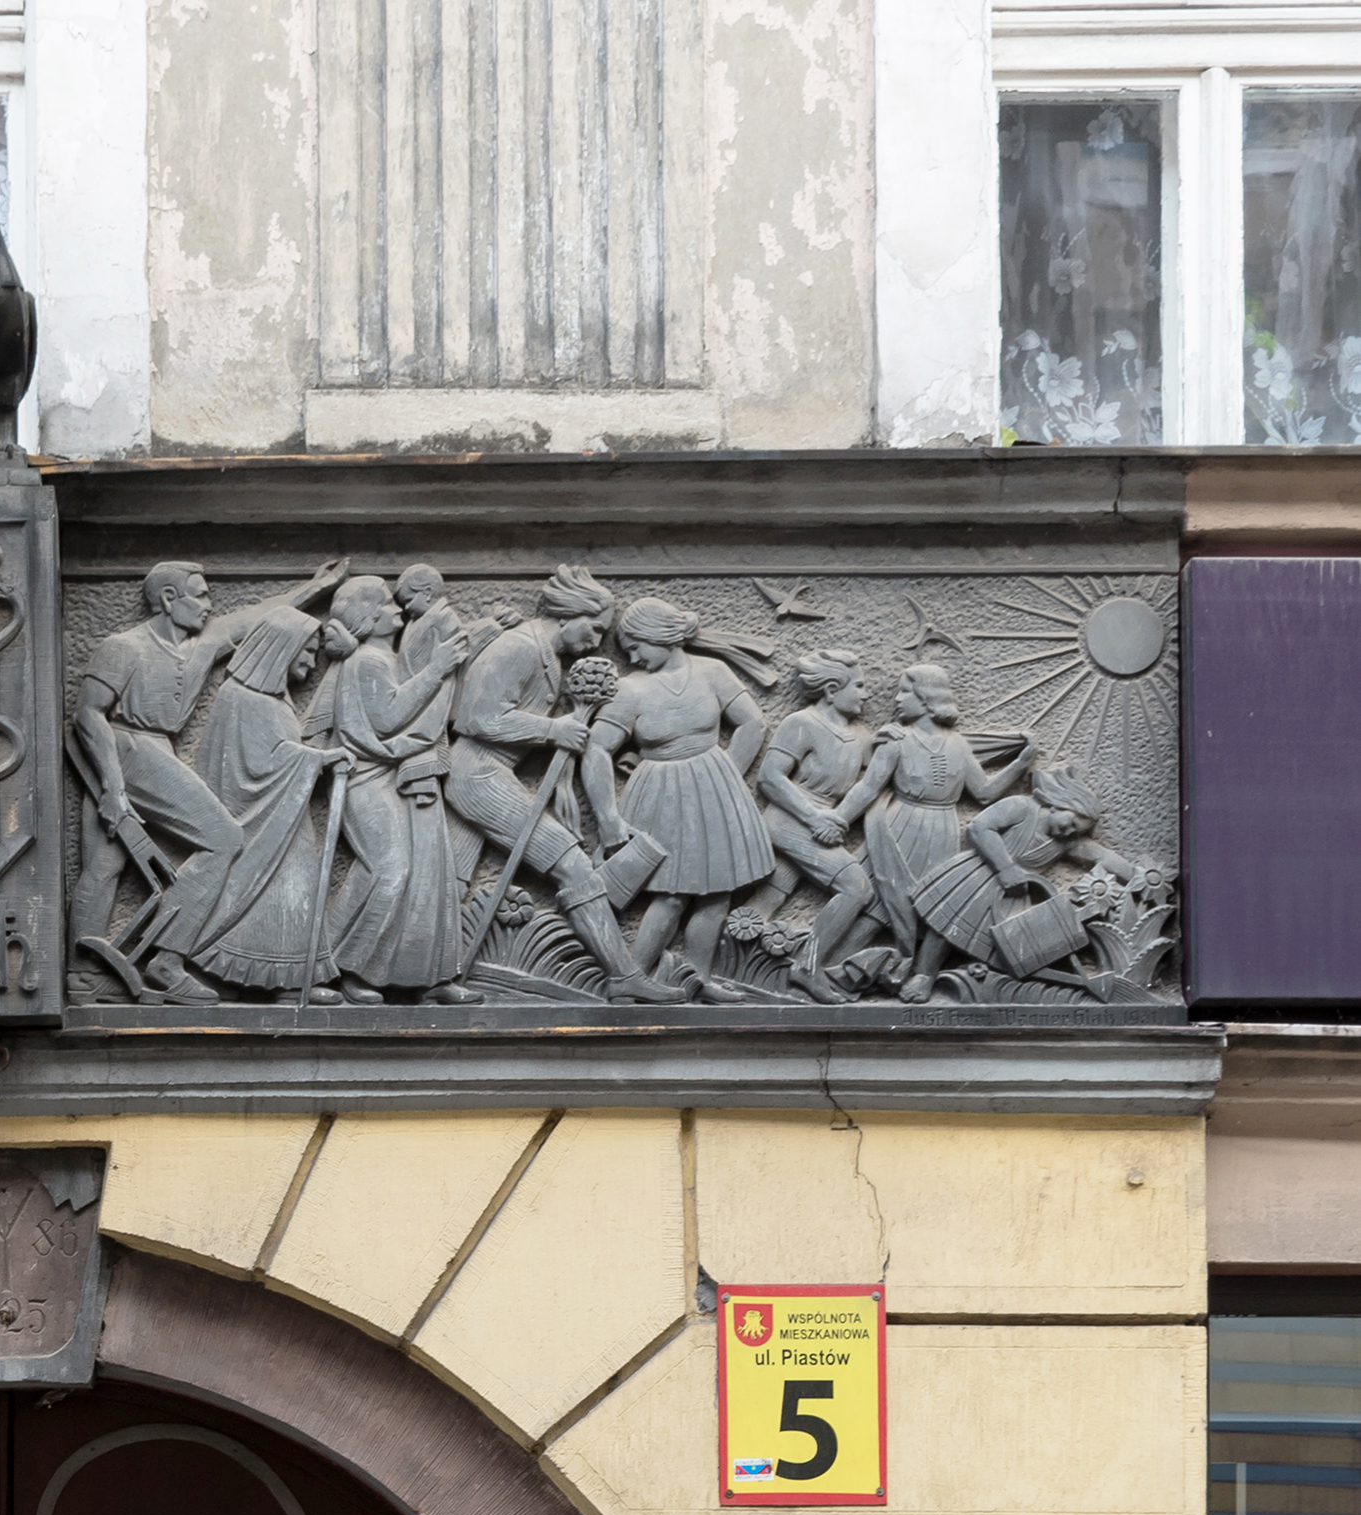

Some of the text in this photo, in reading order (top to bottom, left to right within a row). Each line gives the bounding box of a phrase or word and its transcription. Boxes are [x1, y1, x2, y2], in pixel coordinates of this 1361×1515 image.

[32, 1218, 79, 1256] 86
[787, 1311, 862, 1324] WSPÓLNOTA
[779, 1328, 870, 1340] MIESZKANIOWA
[755, 1348, 851, 1366] ul. Piastów
[775, 1380, 838, 1480] 5
